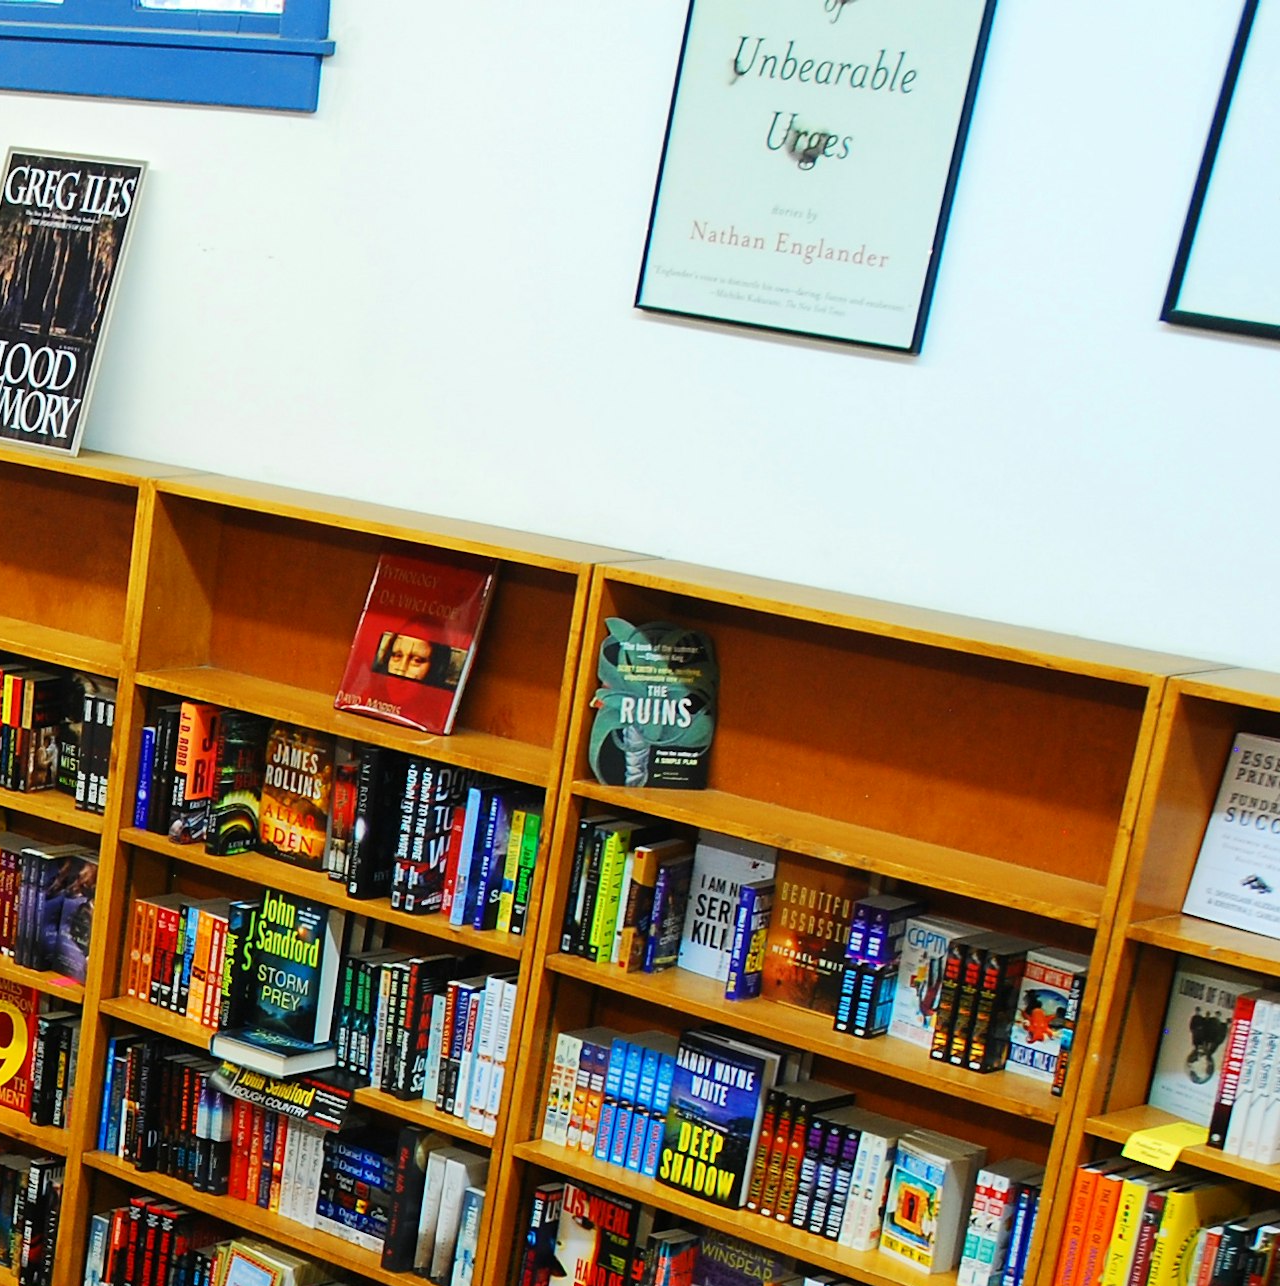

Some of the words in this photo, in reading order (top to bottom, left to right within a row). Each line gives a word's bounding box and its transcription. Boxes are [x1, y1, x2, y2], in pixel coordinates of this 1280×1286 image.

[733, 34, 919, 95] Unbearable
[765, 110, 853, 171] Urges
[4, 165, 81, 214] GREG
[77, 175, 138, 220] ILES
[690, 220, 766, 250] Nathan
[774, 231, 890, 268] Englander
[646, 684, 668, 699] THE
[618, 695, 693, 729] RUINS
[272, 741, 319, 776] JAMES
[264, 768, 324, 800] ROLLINS
[262, 800, 315, 829] ALTAR
[261, 821, 315, 854] EDEN
[262, 889, 296, 929] John
[256, 922, 320, 969] Sandford
[771, 943, 814, 966] MICHAEL
[257, 963, 310, 996] STORM
[260, 984, 300, 1013] PREY
[239, 1069, 265, 1094] John
[265, 1076, 316, 1106] Sandford
[676, 1045, 713, 1072] RANDY
[714, 1055, 755, 1093] WAYNE
[233, 1082, 272, 1106] ROUGH
[269, 1094, 310, 1119] COUNTRY
[690, 1072, 729, 1109] WHITE
[676, 1120, 725, 1163] DEEP
[659, 1148, 737, 1204] SHADOW
[563, 1183, 590, 1218] LIS
[589, 1196, 631, 1238] WIEHL
[701, 1240, 775, 1281] WINSPEAR
